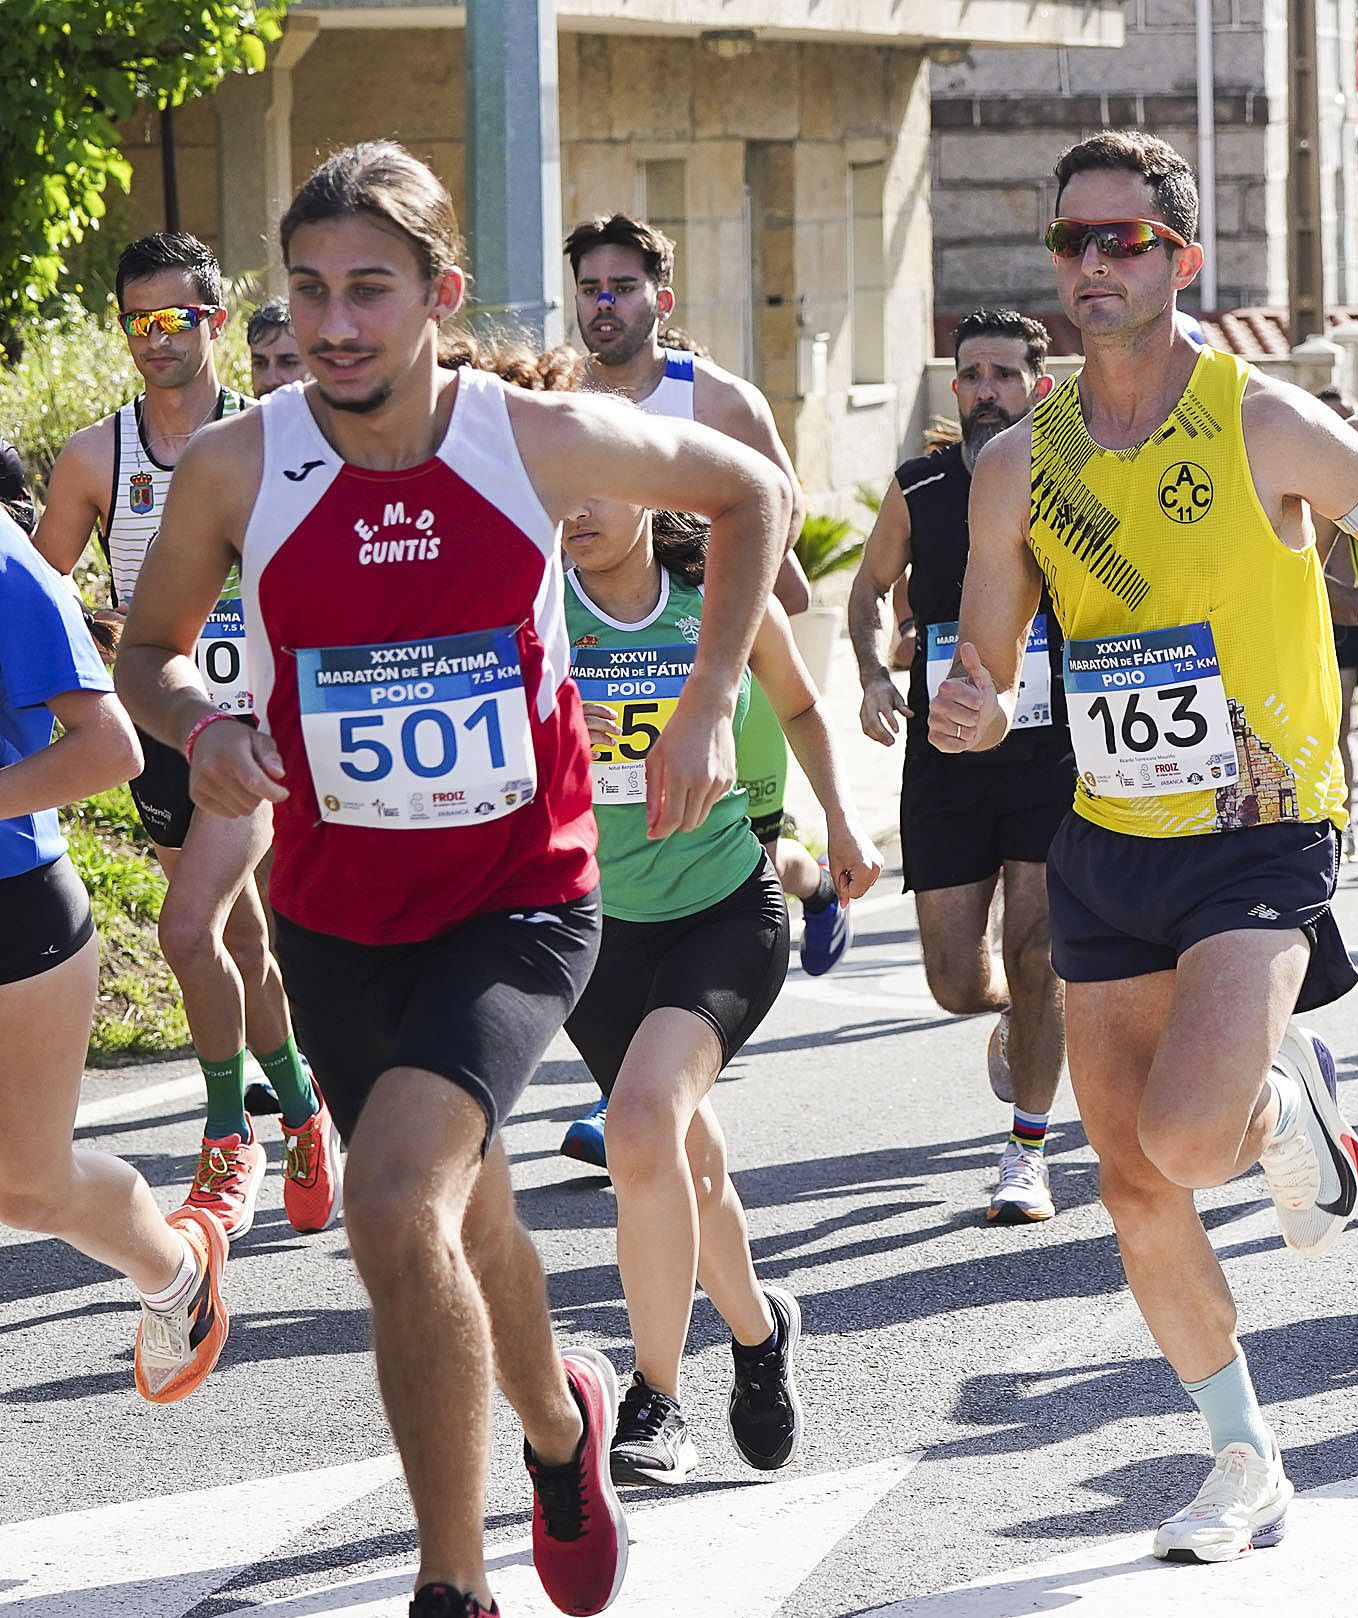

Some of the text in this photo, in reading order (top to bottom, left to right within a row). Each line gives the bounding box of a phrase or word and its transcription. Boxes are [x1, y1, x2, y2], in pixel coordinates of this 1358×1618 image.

[358, 537, 441, 566] CUNTIS
[370, 645, 434, 664] XXXVII
[610, 651, 657, 664] XXXVII
[1069, 644, 1198, 671] MARATÓN DE FÁTIMA
[1096, 639, 1142, 655] XXXVII
[317, 667, 399, 685] MARATÓN
[421, 651, 499, 677] FÁTIMA
[569, 667, 629, 679] MARATÓN
[647, 663, 695, 677] FÁTIM
[1102, 657, 1218, 687] POIO 7.5 KM
[370, 664, 521, 704] POIO 7.5 KM
[607, 681, 656, 696] POIO
[1087, 685, 1208, 754] 163
[339, 698, 506, 782] 501
[1155, 763, 1179, 773] FROIZ
[432, 791, 465, 803] FROIZ
